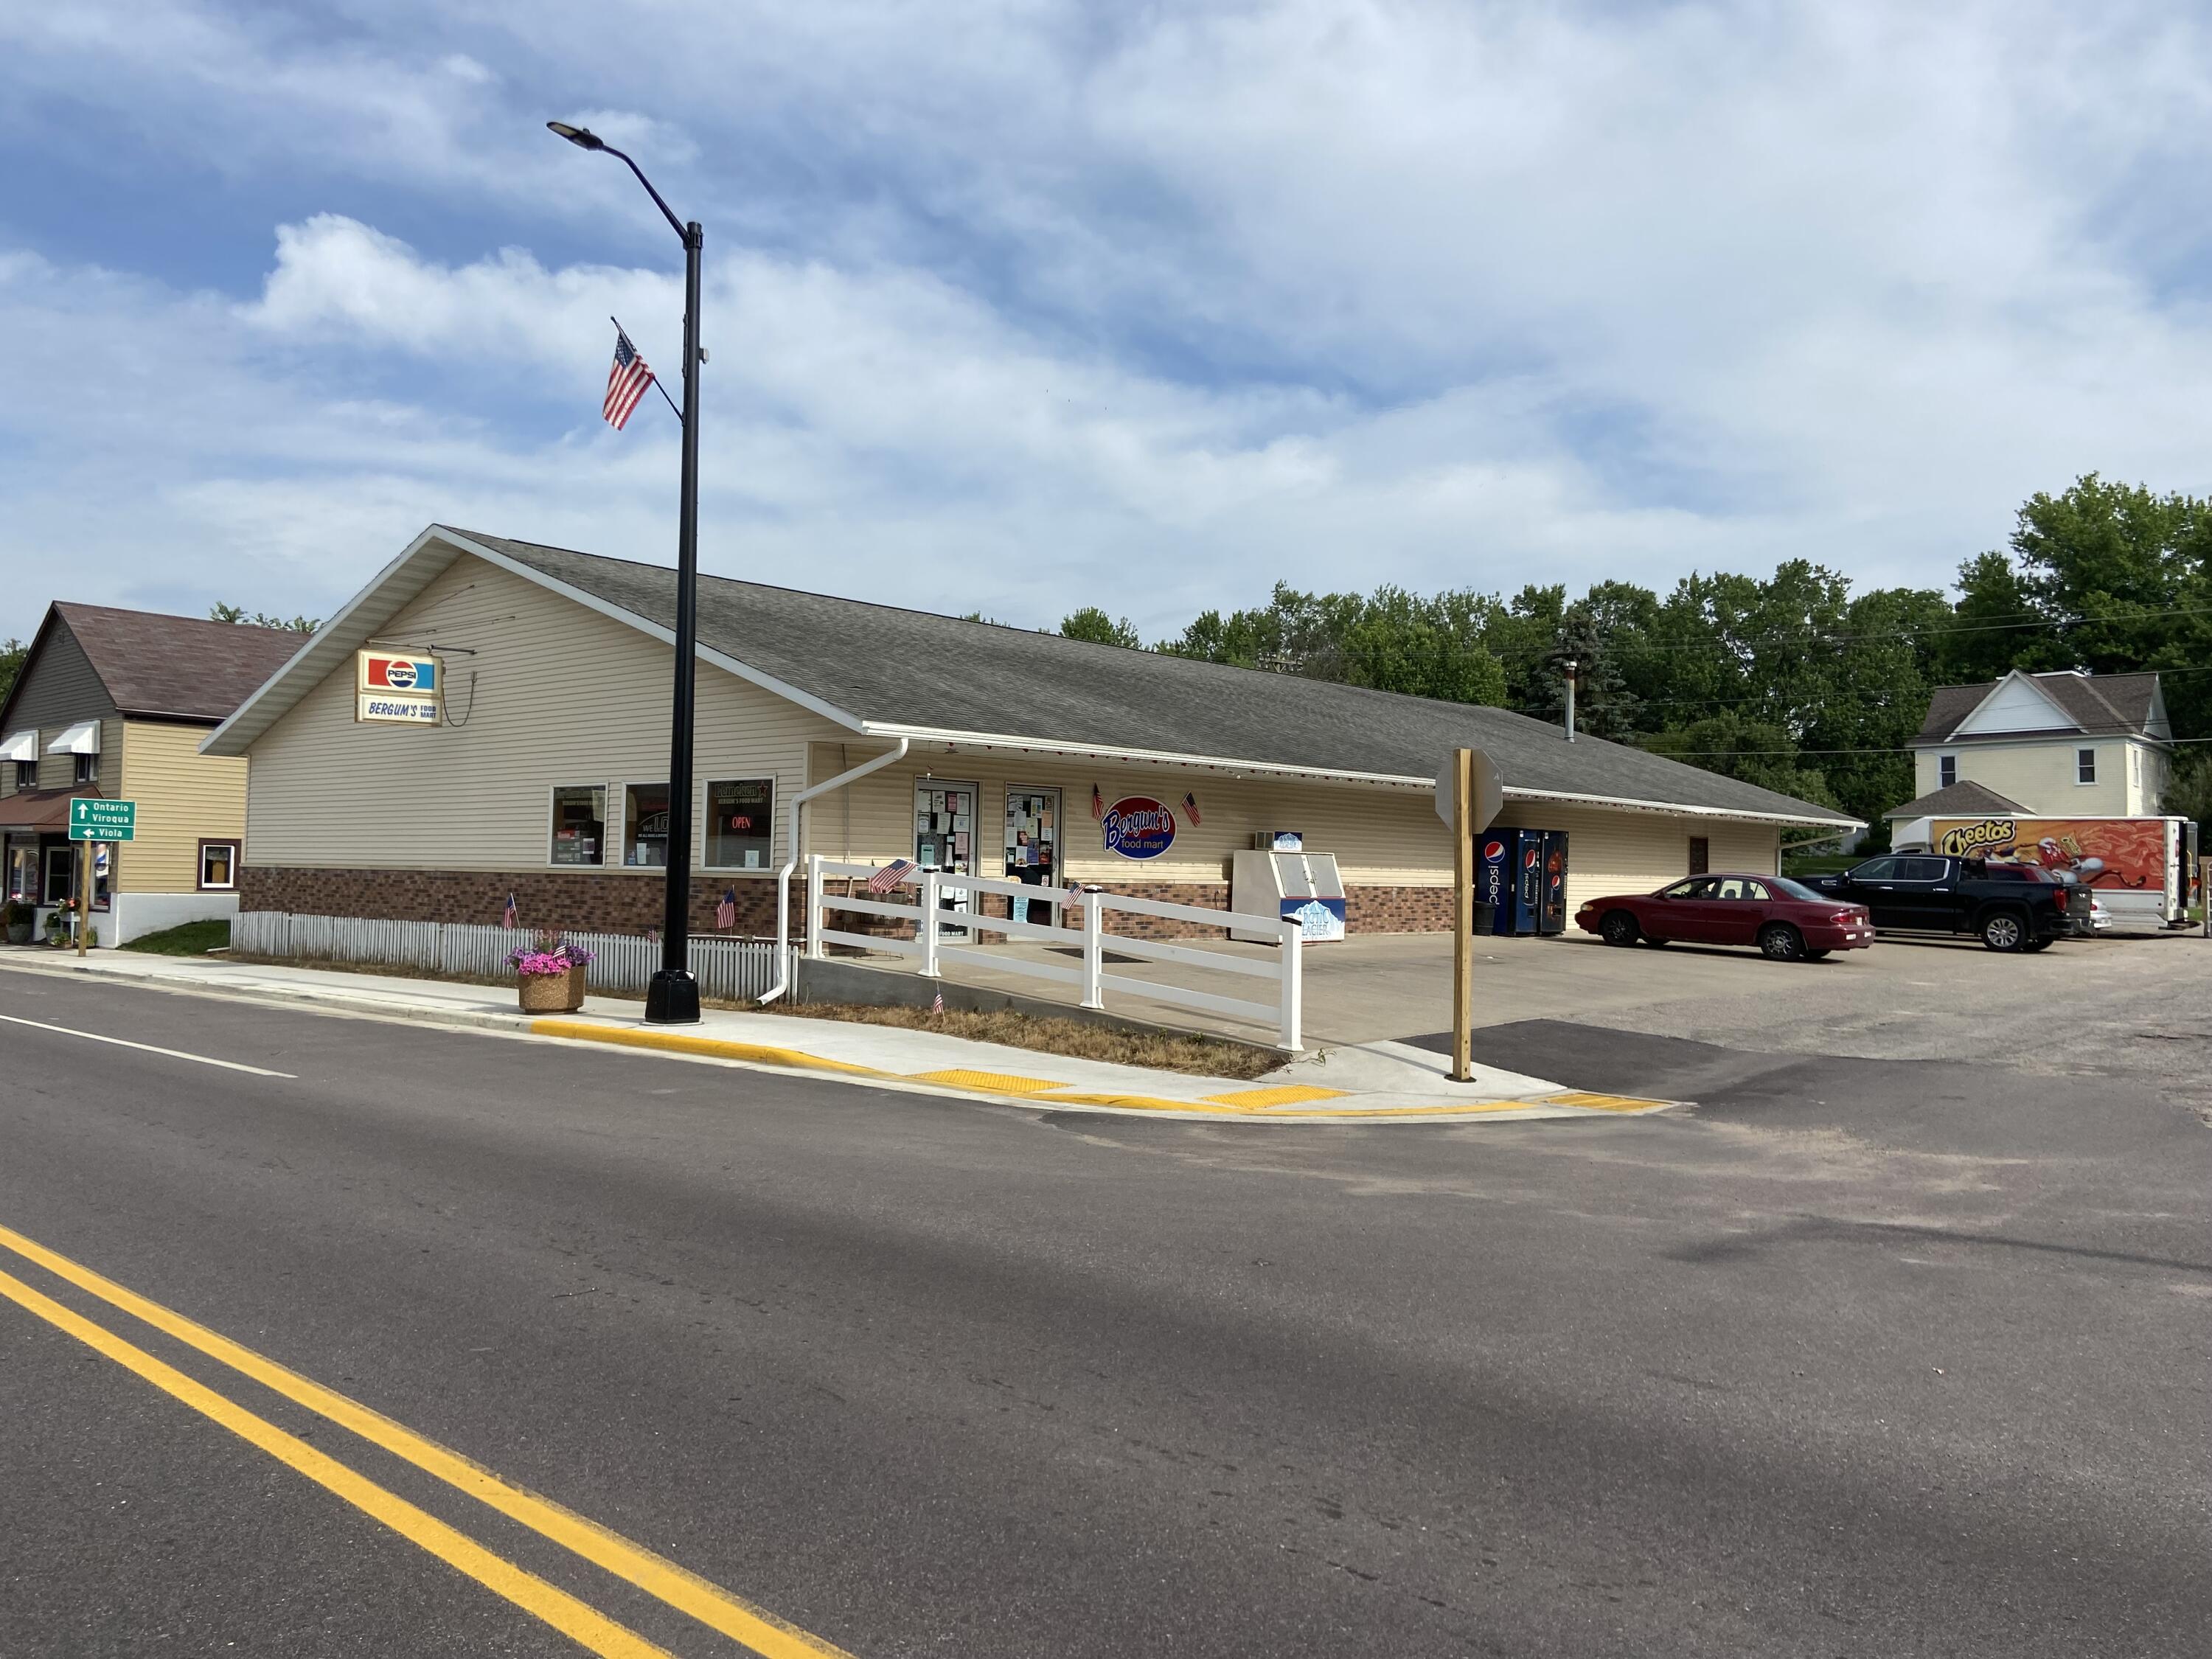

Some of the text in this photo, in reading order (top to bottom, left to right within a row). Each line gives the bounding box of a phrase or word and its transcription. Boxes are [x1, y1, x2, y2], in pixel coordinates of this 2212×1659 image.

[388, 669, 416, 678] PEPSI
[369, 702, 417, 717] BERGUM'S
[714, 783, 757, 798] Heineken
[94, 802, 129, 812] Ontario
[92, 813, 129, 824] Viroqua
[732, 816, 751, 829] OPEN
[99, 829, 122, 838] Viola
[1102, 805, 1170, 852] Bergum's
[1121, 839, 1164, 849] food mart
[1943, 820, 2014, 855] Cheetos
[1488, 866, 1500, 905] pepsi
[1302, 908, 1329, 924] RCTIC
[1302, 924, 1329, 936] LACIER
